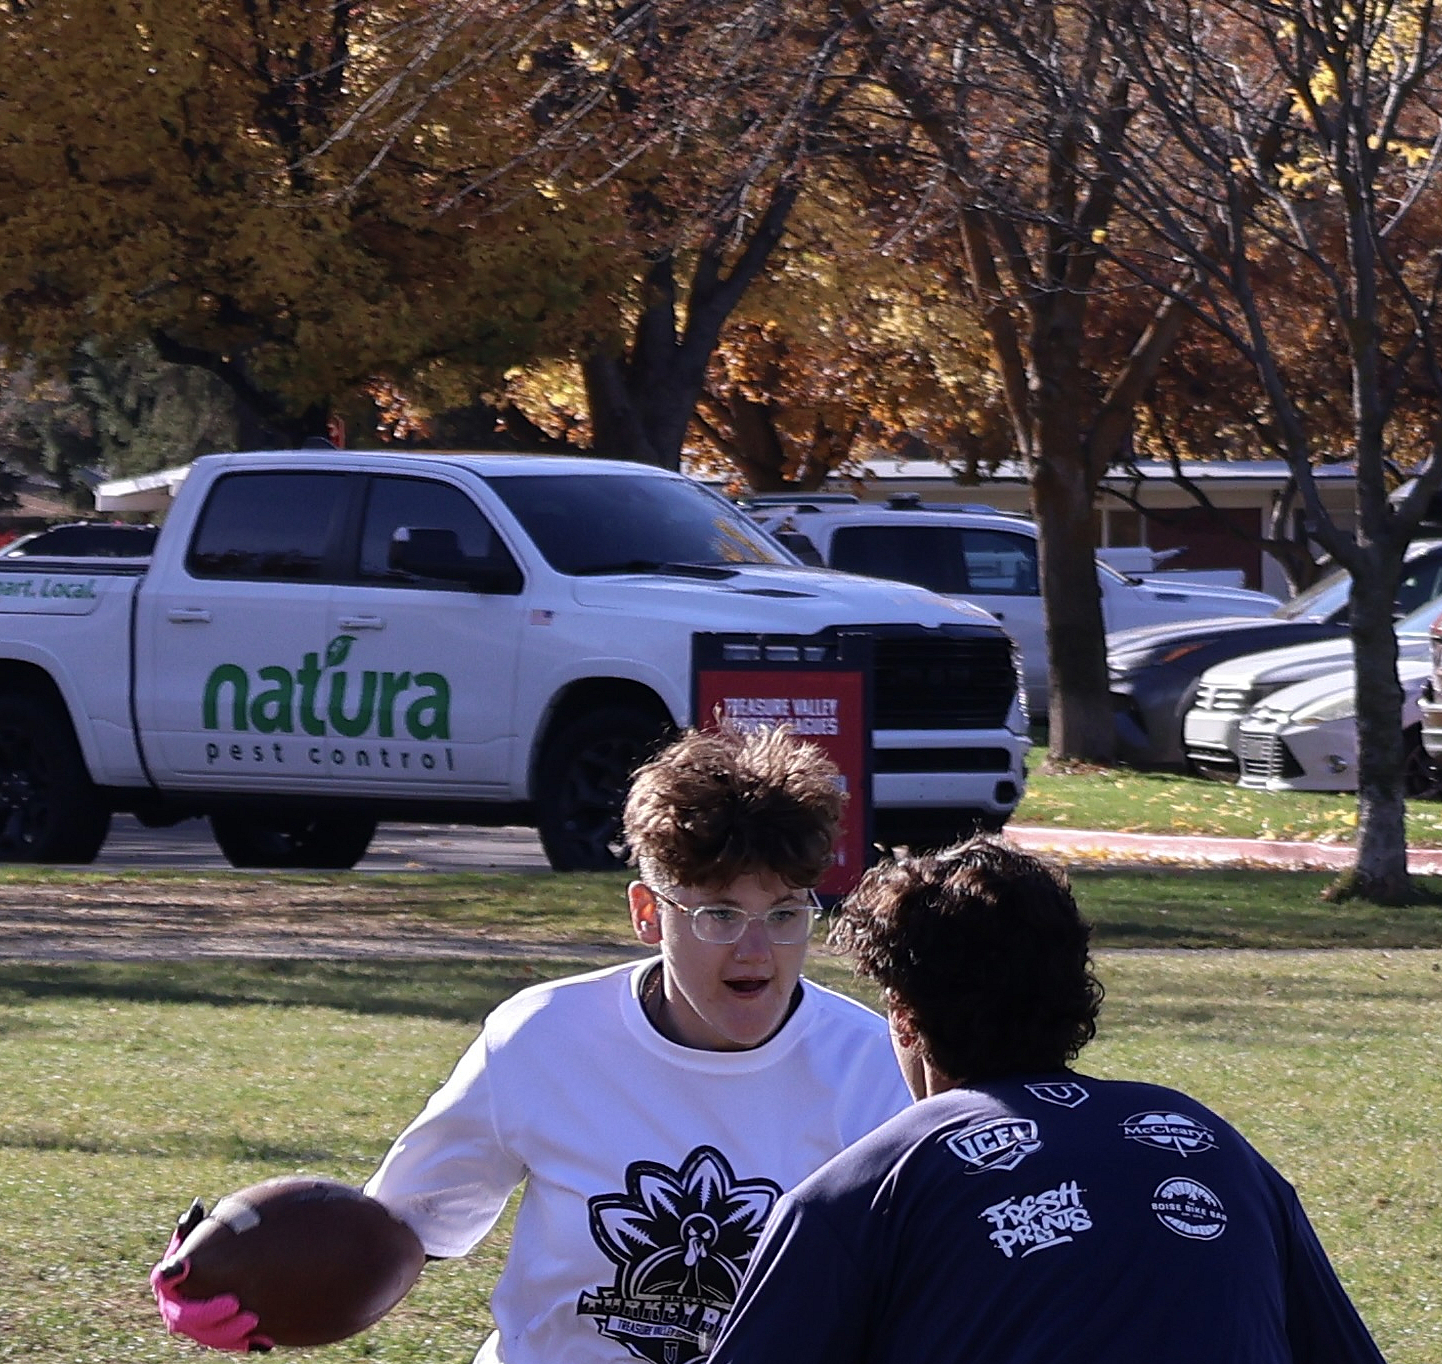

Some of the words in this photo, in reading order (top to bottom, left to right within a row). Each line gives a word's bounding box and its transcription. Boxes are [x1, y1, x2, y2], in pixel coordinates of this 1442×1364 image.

[40, 577, 98, 599] Local.
[202, 650, 452, 741] natura
[792, 698, 838, 716] VALLEY
[206, 742, 285, 765] pest
[308, 746, 455, 772] control
[978, 1180, 1087, 1230] FRESH
[1151, 1202, 1182, 1212] BOISE
[1184, 1204, 1207, 1216] BIKE
[581, 1295, 699, 1328] TURKEY
